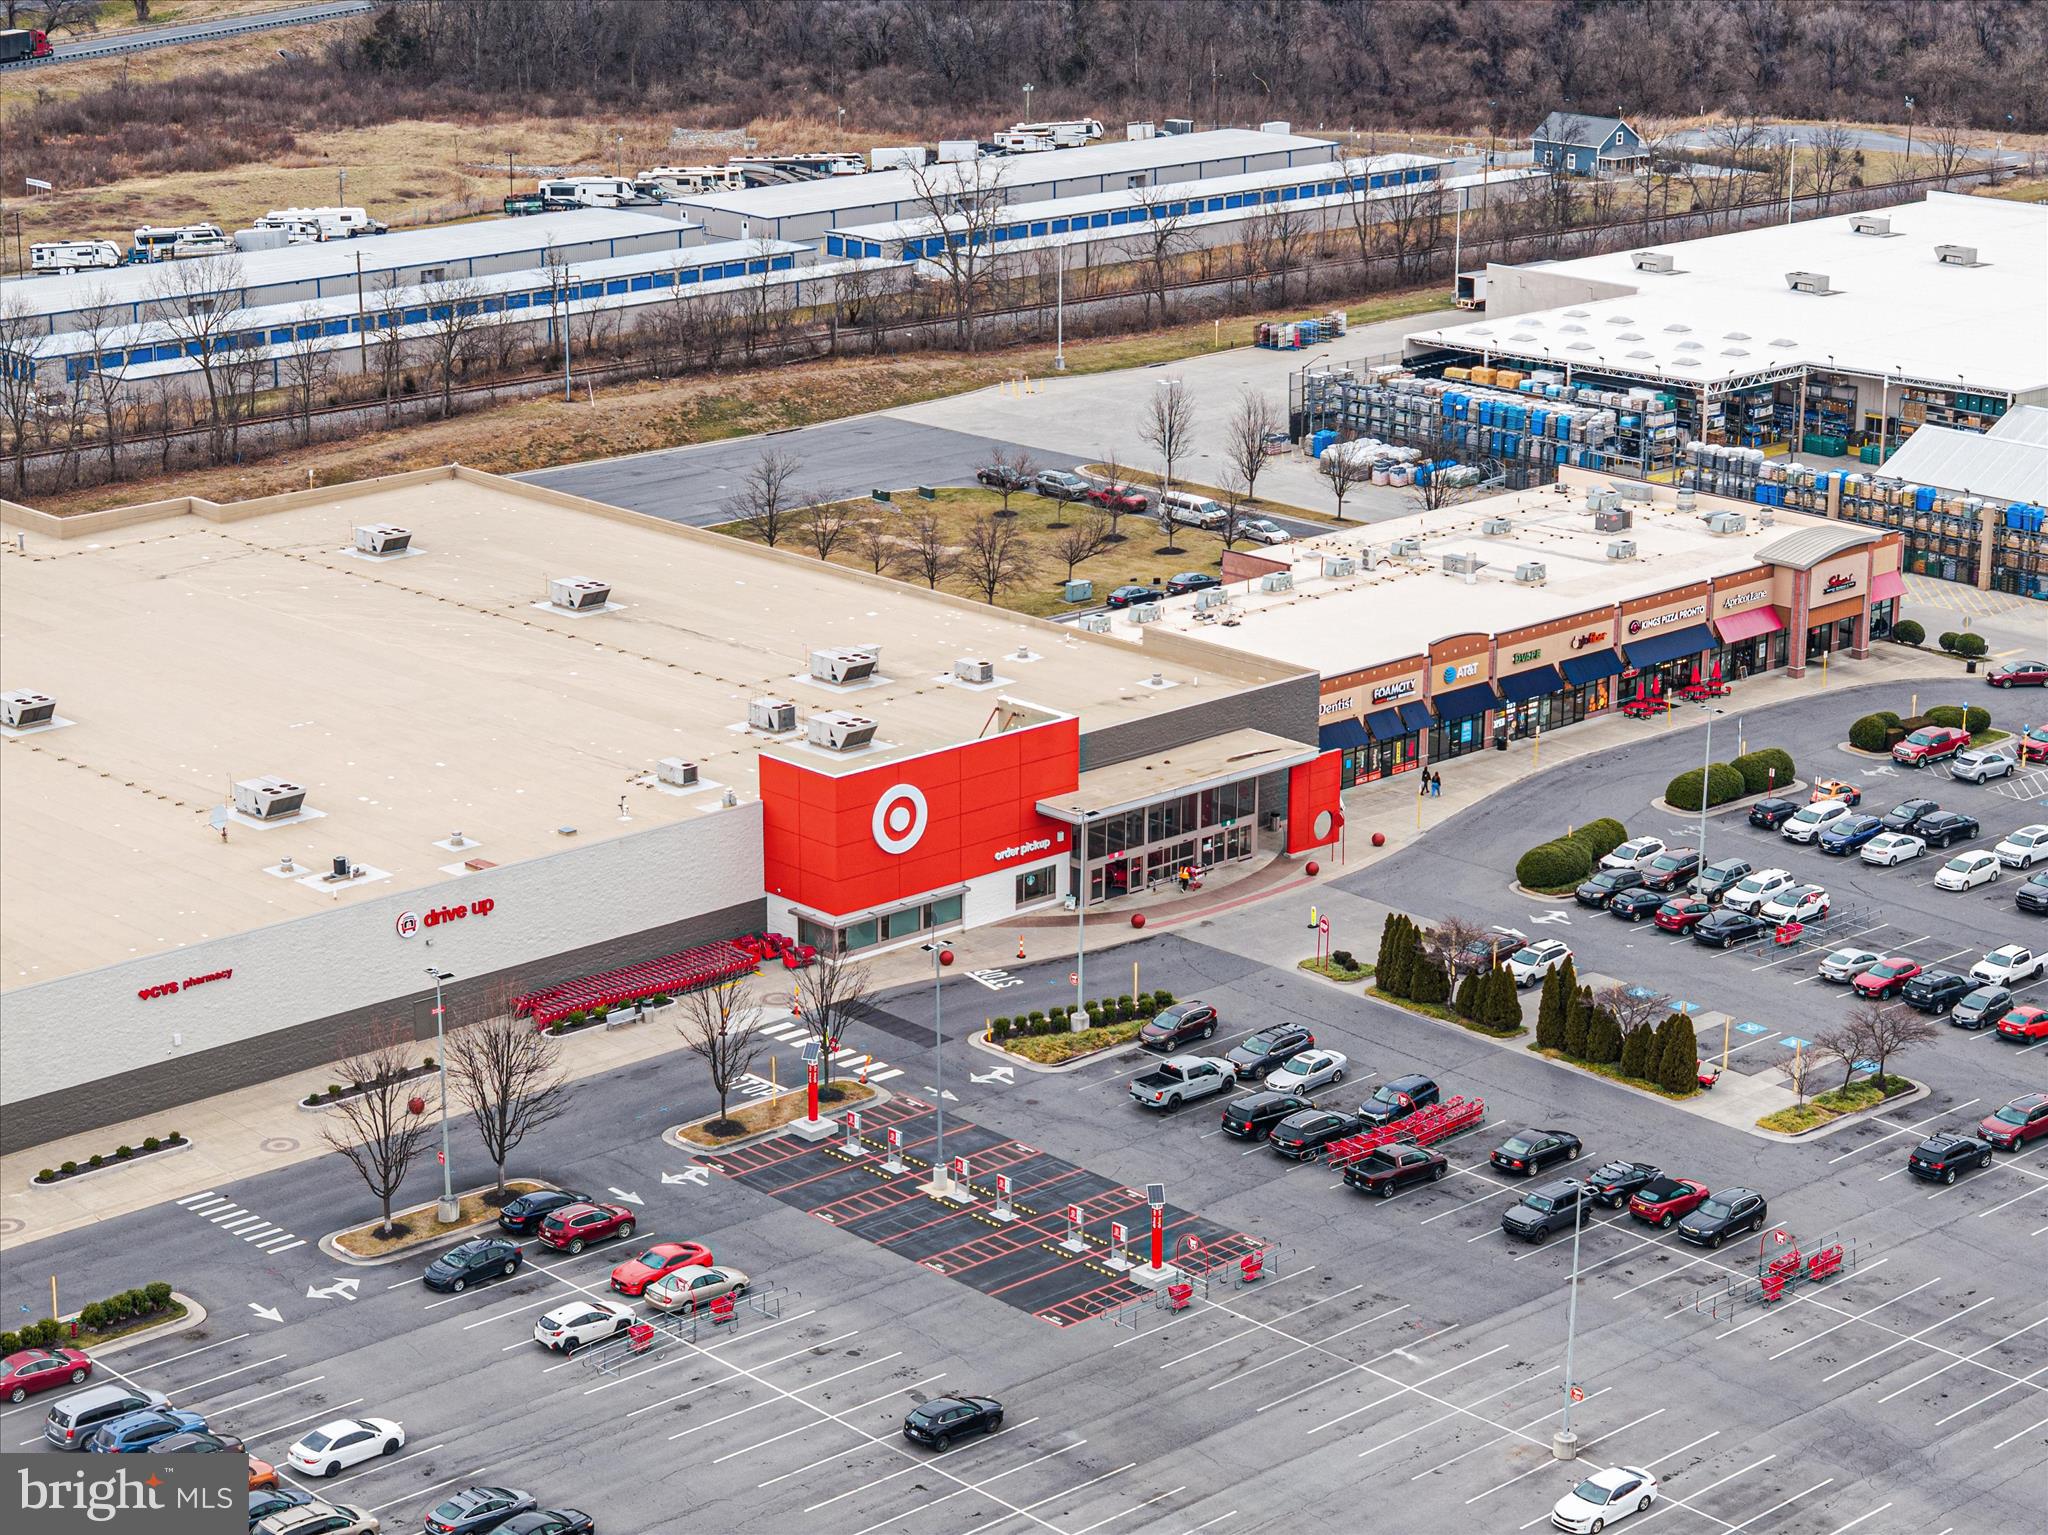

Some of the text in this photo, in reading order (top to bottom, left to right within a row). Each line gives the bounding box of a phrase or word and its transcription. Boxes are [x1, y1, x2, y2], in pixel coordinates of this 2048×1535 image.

[1724, 590, 1767, 608] Apricot Lane
[1641, 605, 1706, 630] KINGS PIZZA PRONTO
[1456, 663, 1479, 679] AT&T
[1319, 697, 1353, 715] Dentist
[995, 839, 1051, 861] order pickup
[424, 898, 494, 927] drive up
[150, 969, 233, 998] CVS pharmacy
[974, 969, 1024, 988] STOP
[725, 1075, 780, 1097] STOP
